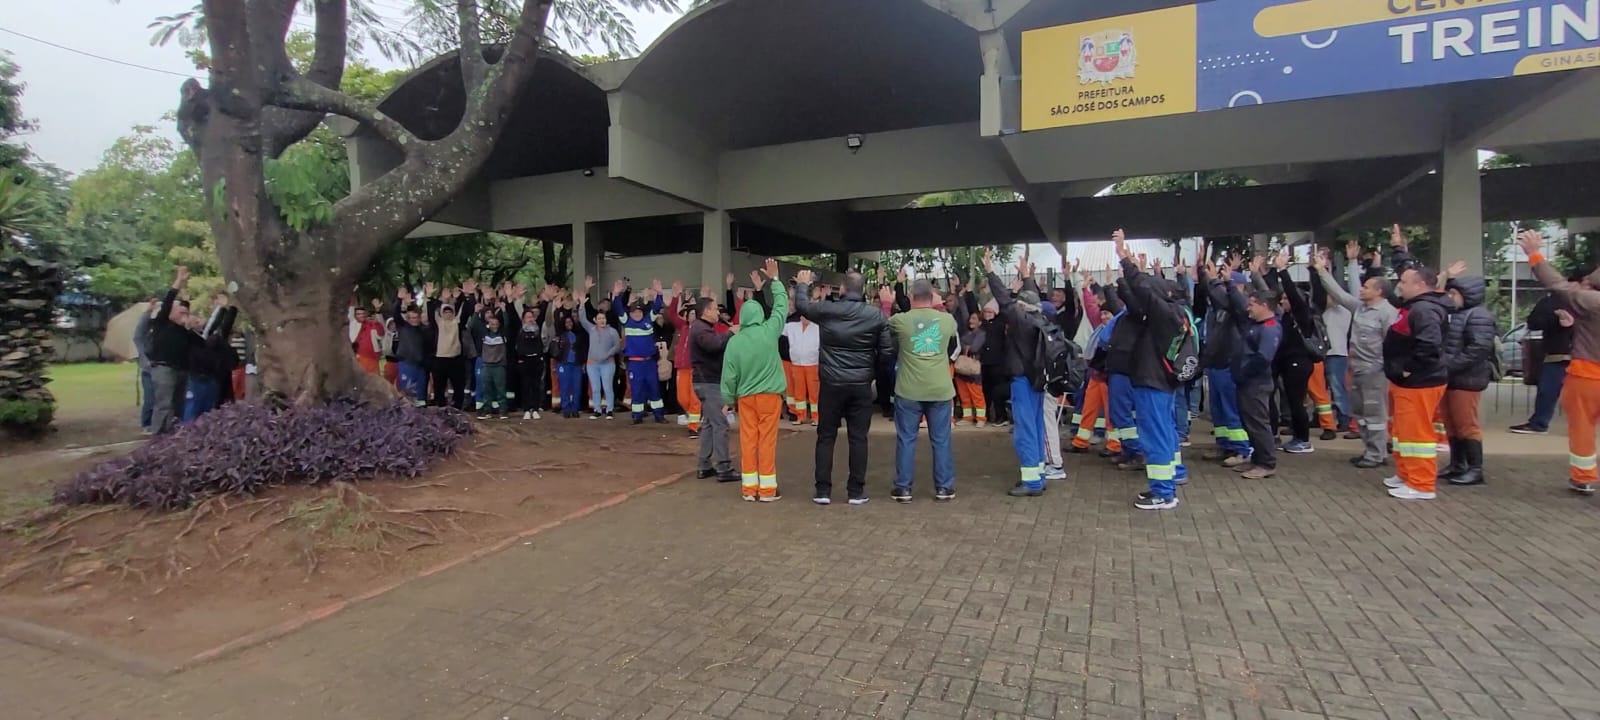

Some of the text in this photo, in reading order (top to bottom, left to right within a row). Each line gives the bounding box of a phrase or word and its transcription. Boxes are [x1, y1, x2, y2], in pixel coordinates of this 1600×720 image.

[1078, 86, 1135, 100] PREFEITURA
[1050, 94, 1165, 116] SÃO JOSÉ DOS CAMPOS
